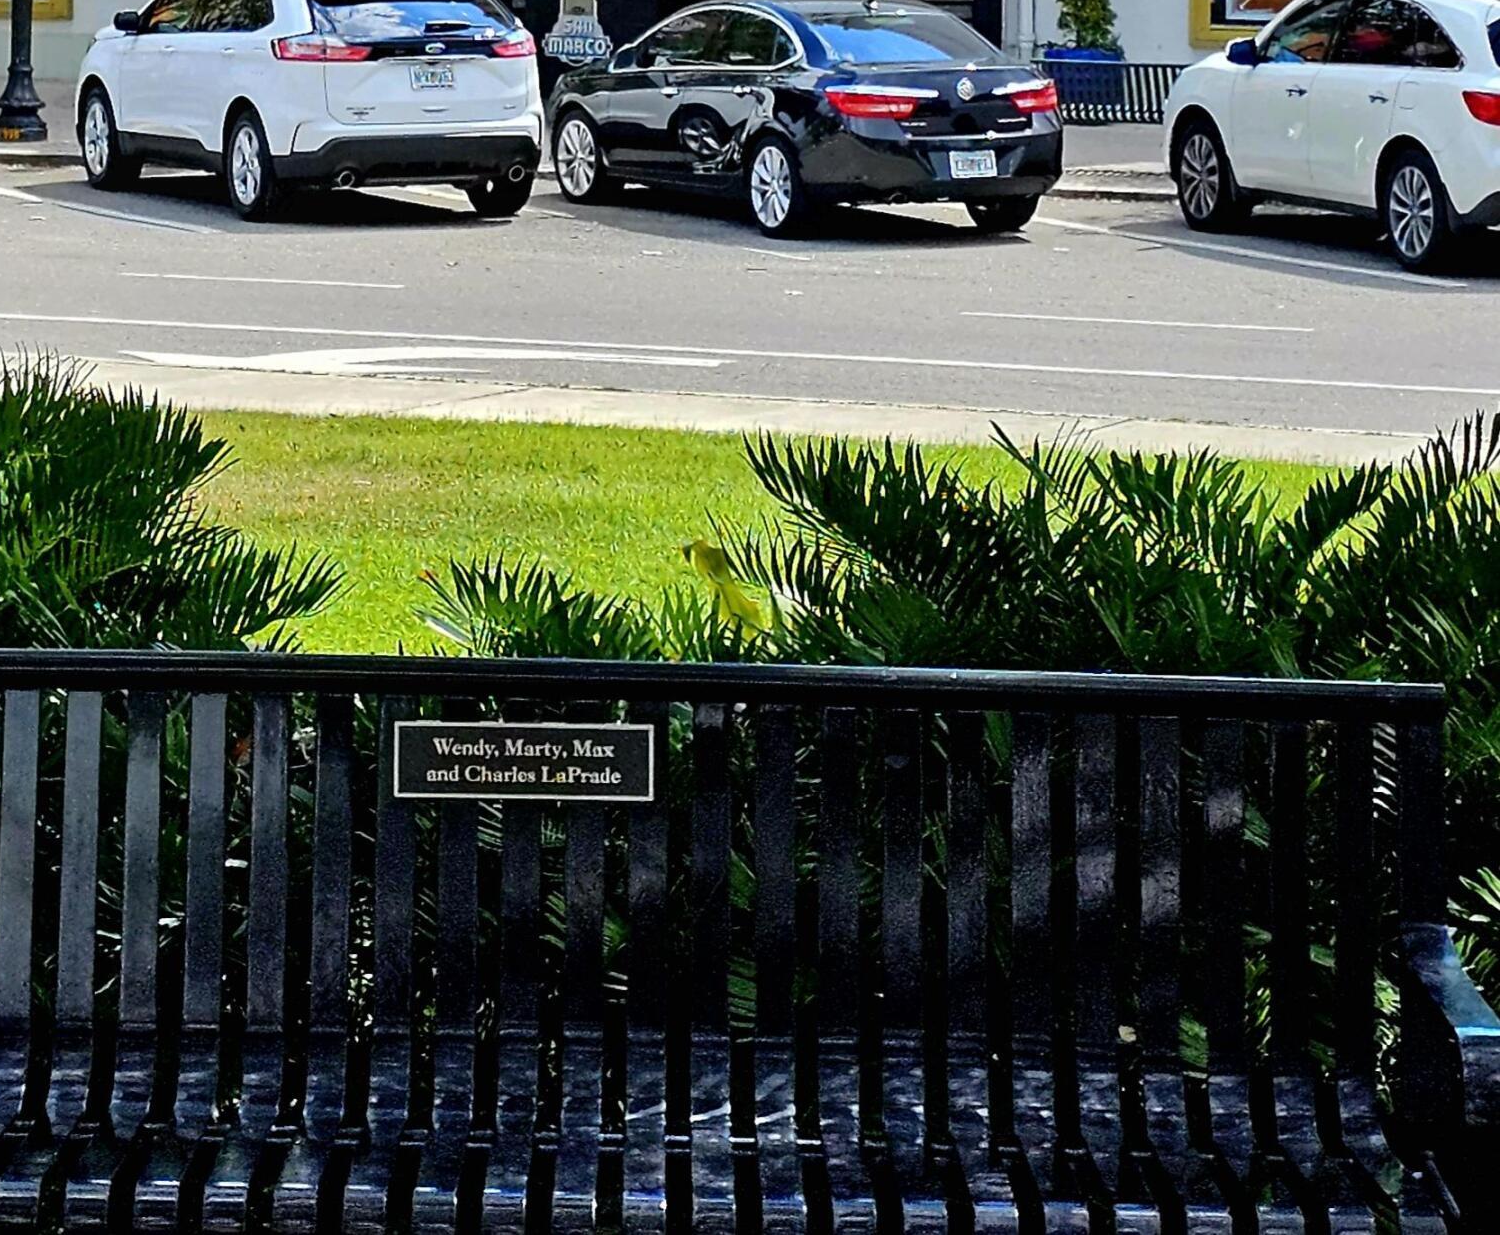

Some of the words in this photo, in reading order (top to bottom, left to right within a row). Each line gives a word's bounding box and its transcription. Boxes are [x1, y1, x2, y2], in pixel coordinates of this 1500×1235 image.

[564, 19, 593, 34] SAN
[549, 37, 606, 54] MARCO
[432, 737, 500, 758] Wendy,
[505, 738, 568, 760] Marty,
[572, 739, 615, 758] Max
[426, 765, 460, 783] and
[464, 765, 536, 784] Charles
[540, 767, 622, 785] LaPrade
